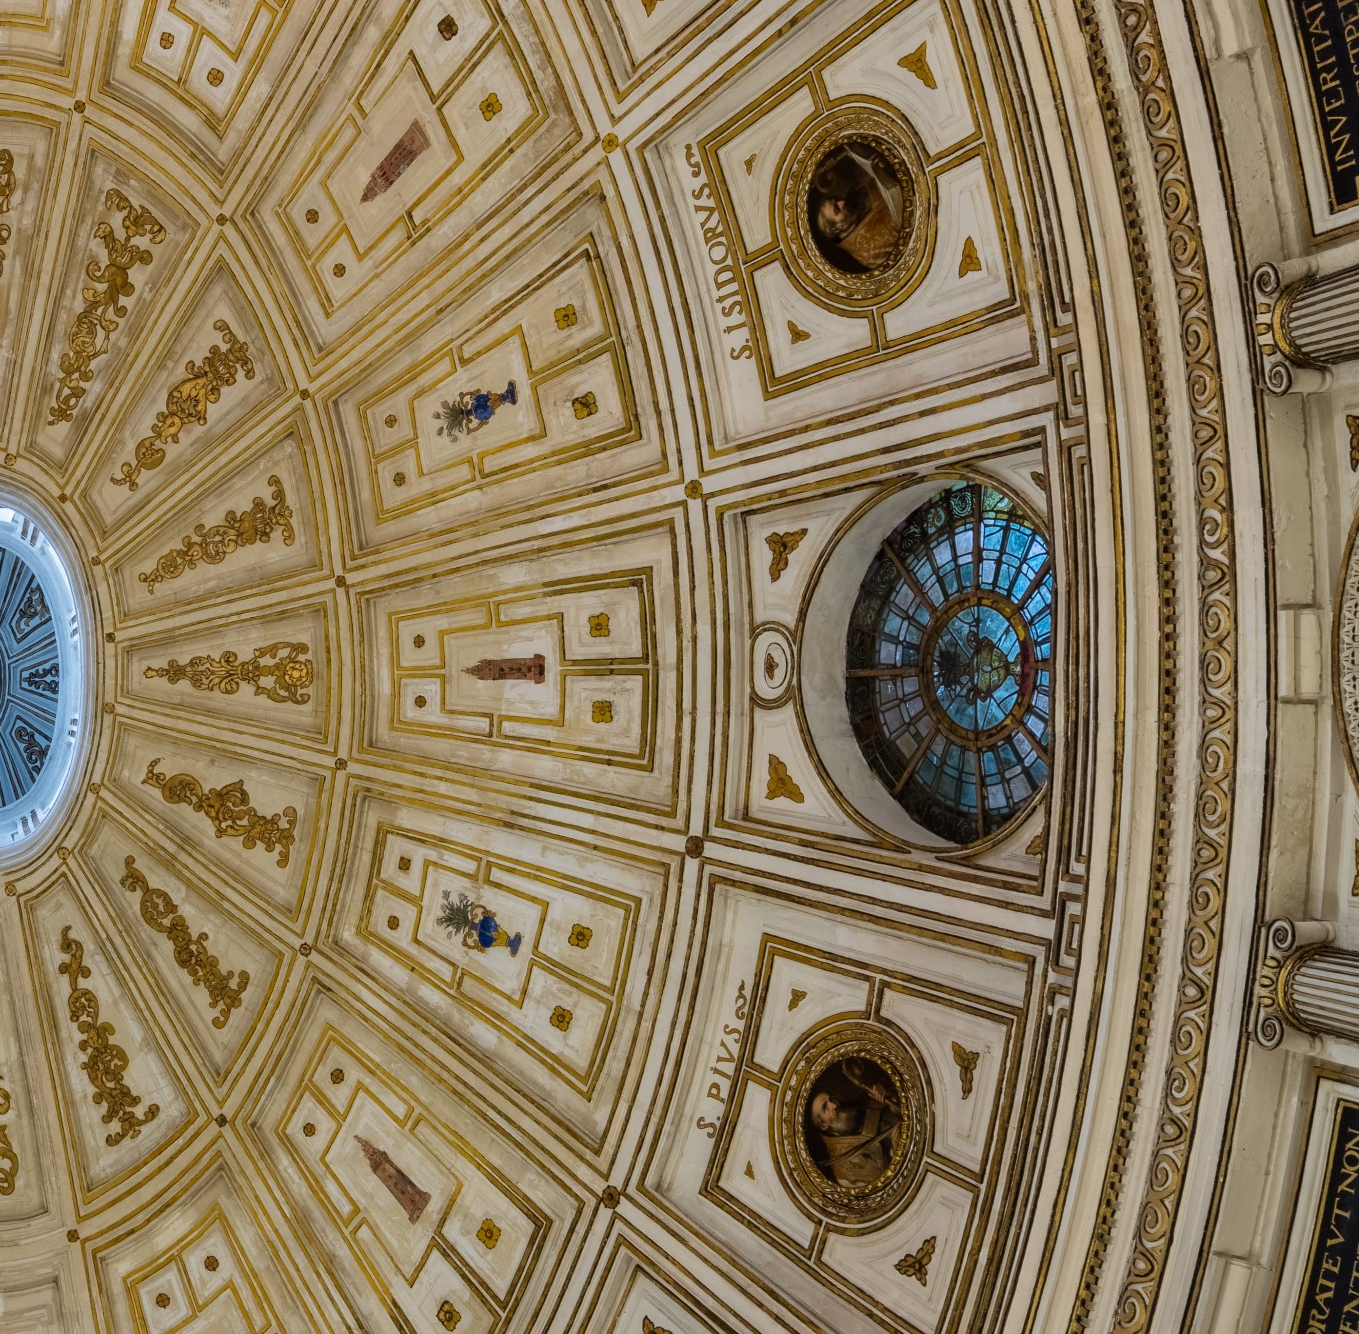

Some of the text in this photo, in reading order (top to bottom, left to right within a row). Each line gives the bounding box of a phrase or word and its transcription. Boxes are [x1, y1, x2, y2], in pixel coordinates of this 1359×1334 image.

[691, 181, 754, 360] S. ISIDORVS
[696, 1024, 742, 1139] S. PIVS
[1326, 1197, 1351, 1247] VT
